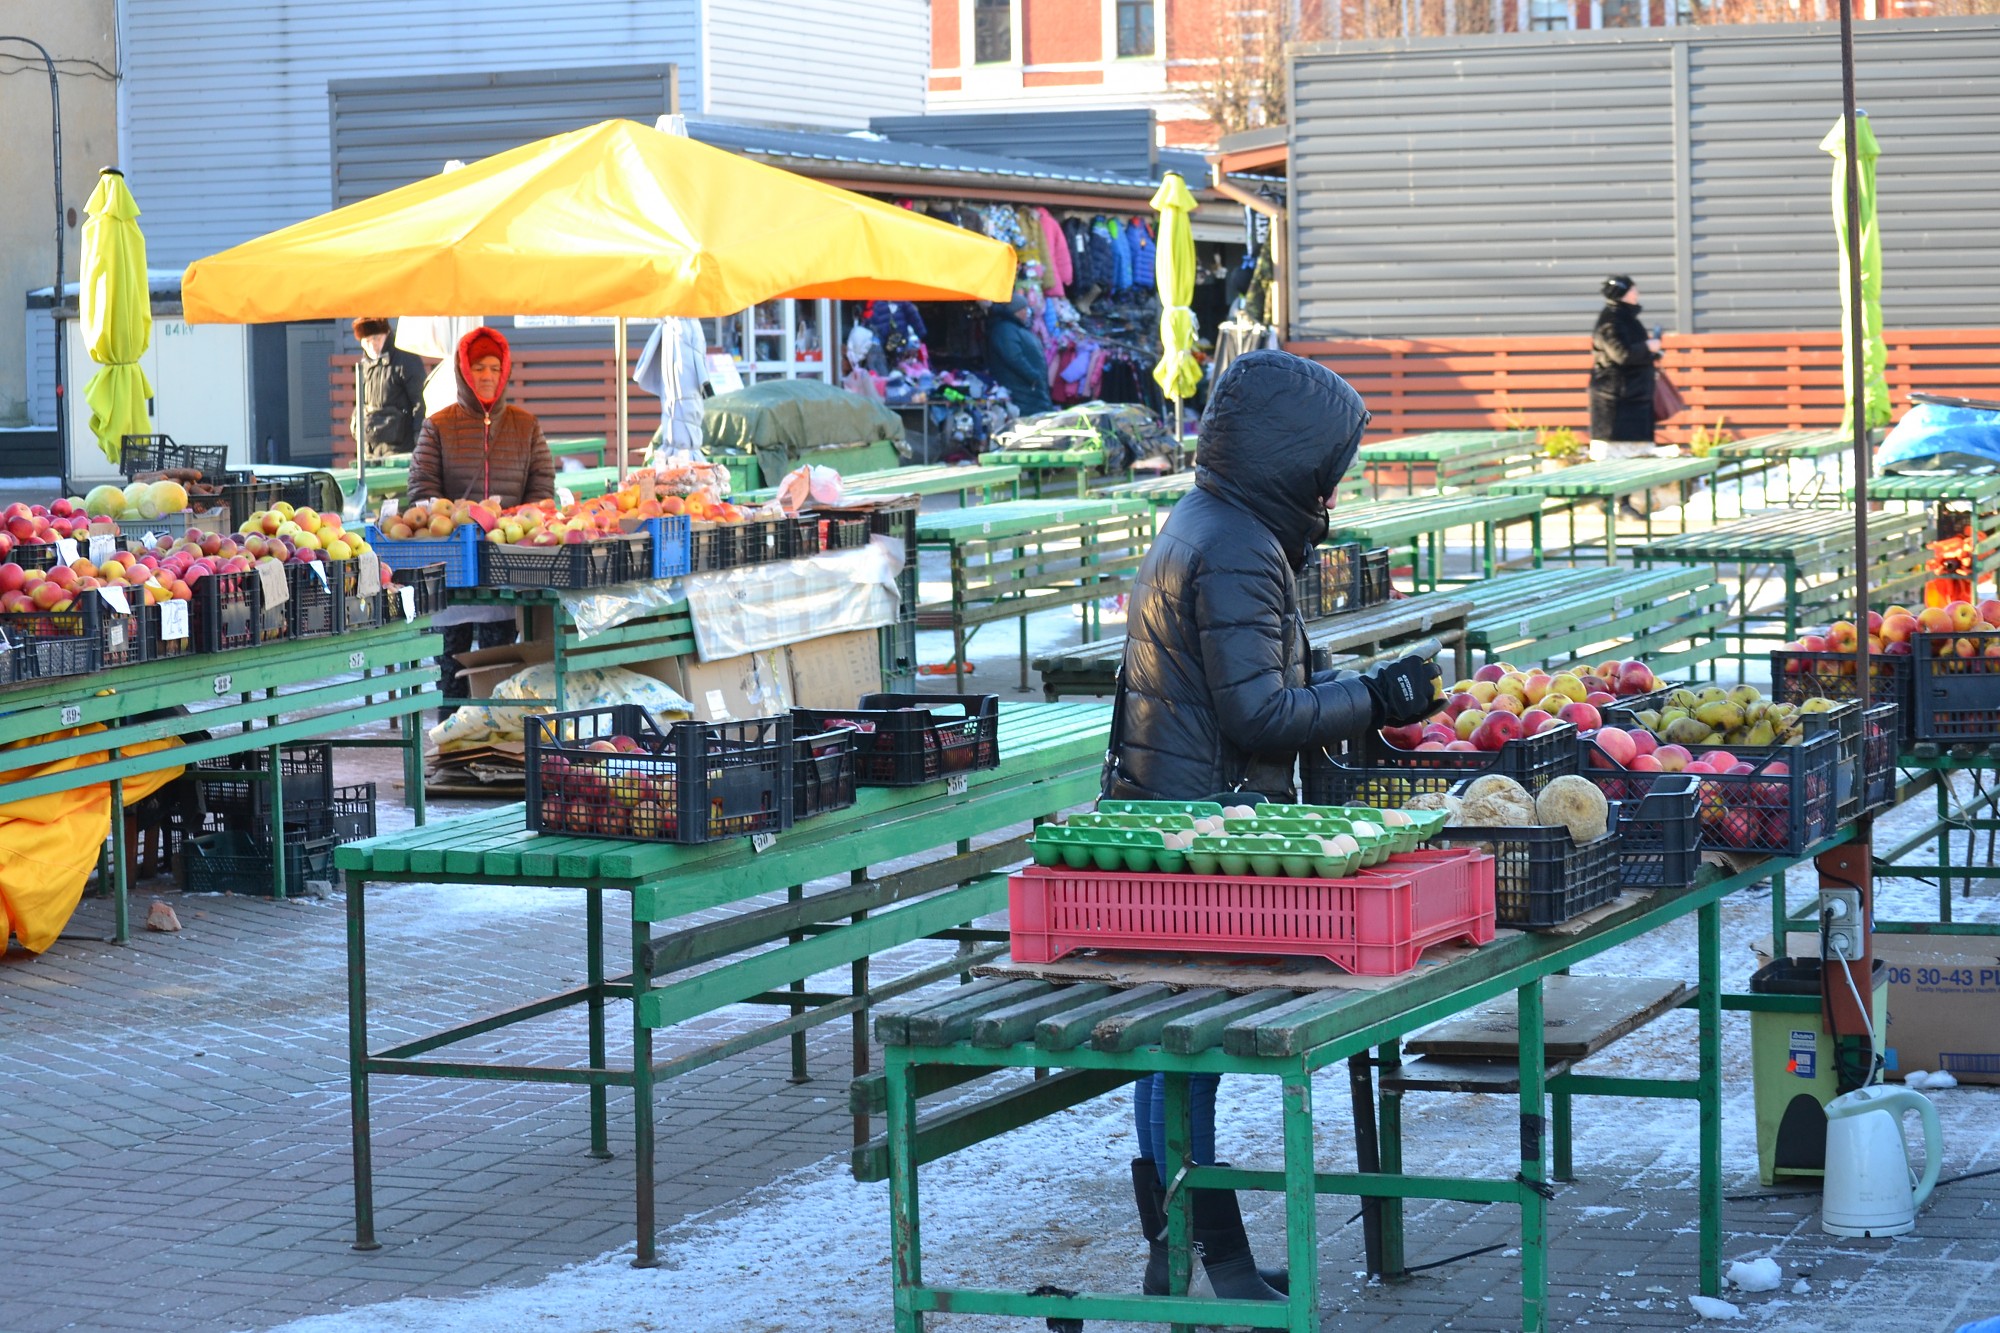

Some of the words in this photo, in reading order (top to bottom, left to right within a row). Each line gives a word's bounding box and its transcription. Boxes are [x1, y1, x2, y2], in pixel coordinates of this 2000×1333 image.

[66, 709, 77, 722] 89
[1889, 967, 1911, 984] 06
[1917, 968, 1974, 986] 30-43
